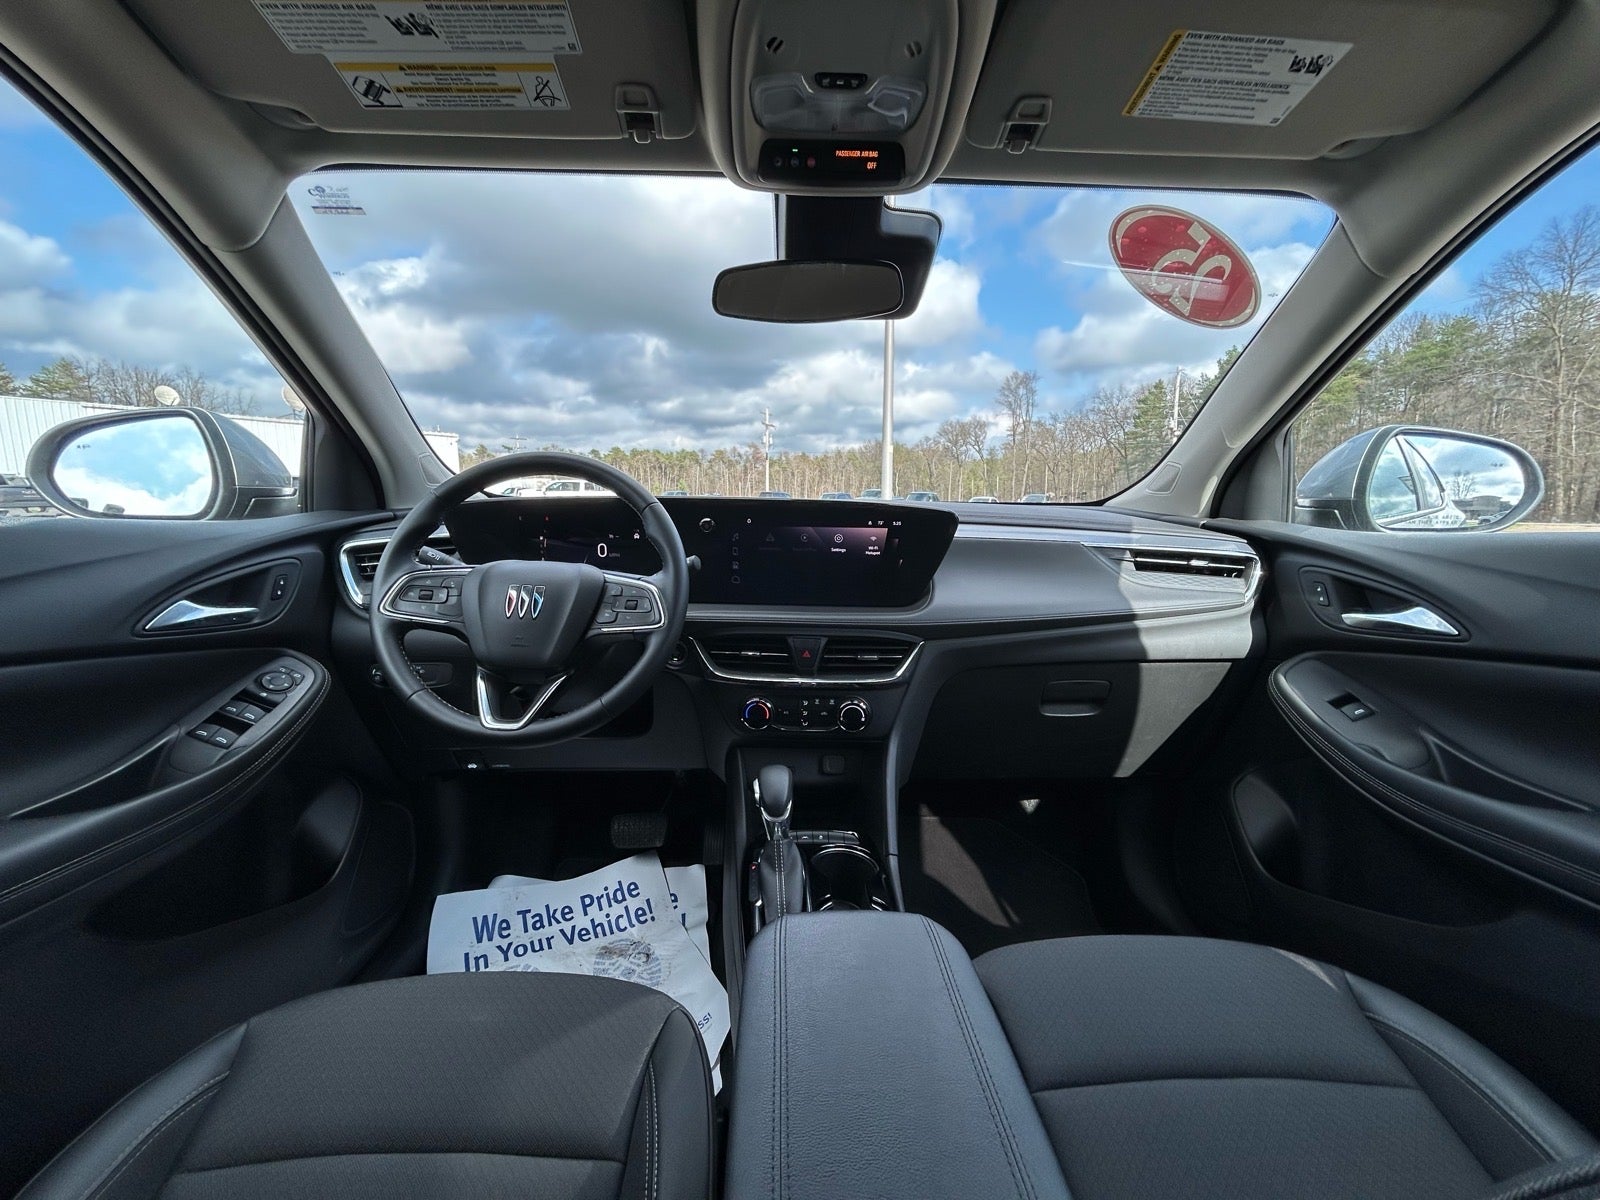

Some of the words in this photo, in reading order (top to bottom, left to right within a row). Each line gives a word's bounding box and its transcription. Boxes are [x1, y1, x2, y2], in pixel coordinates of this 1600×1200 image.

[836, 150, 861, 158] PASSENGER
[867, 161, 877, 169] OFF
[597, 542, 608, 558] 0
[472, 912, 511, 944] We
[517, 903, 574, 934] Take
[579, 880, 641, 917] Pride
[463, 952, 489, 972] In
[495, 934, 555, 964] Your
[559, 898, 656, 946] Vehicle!
